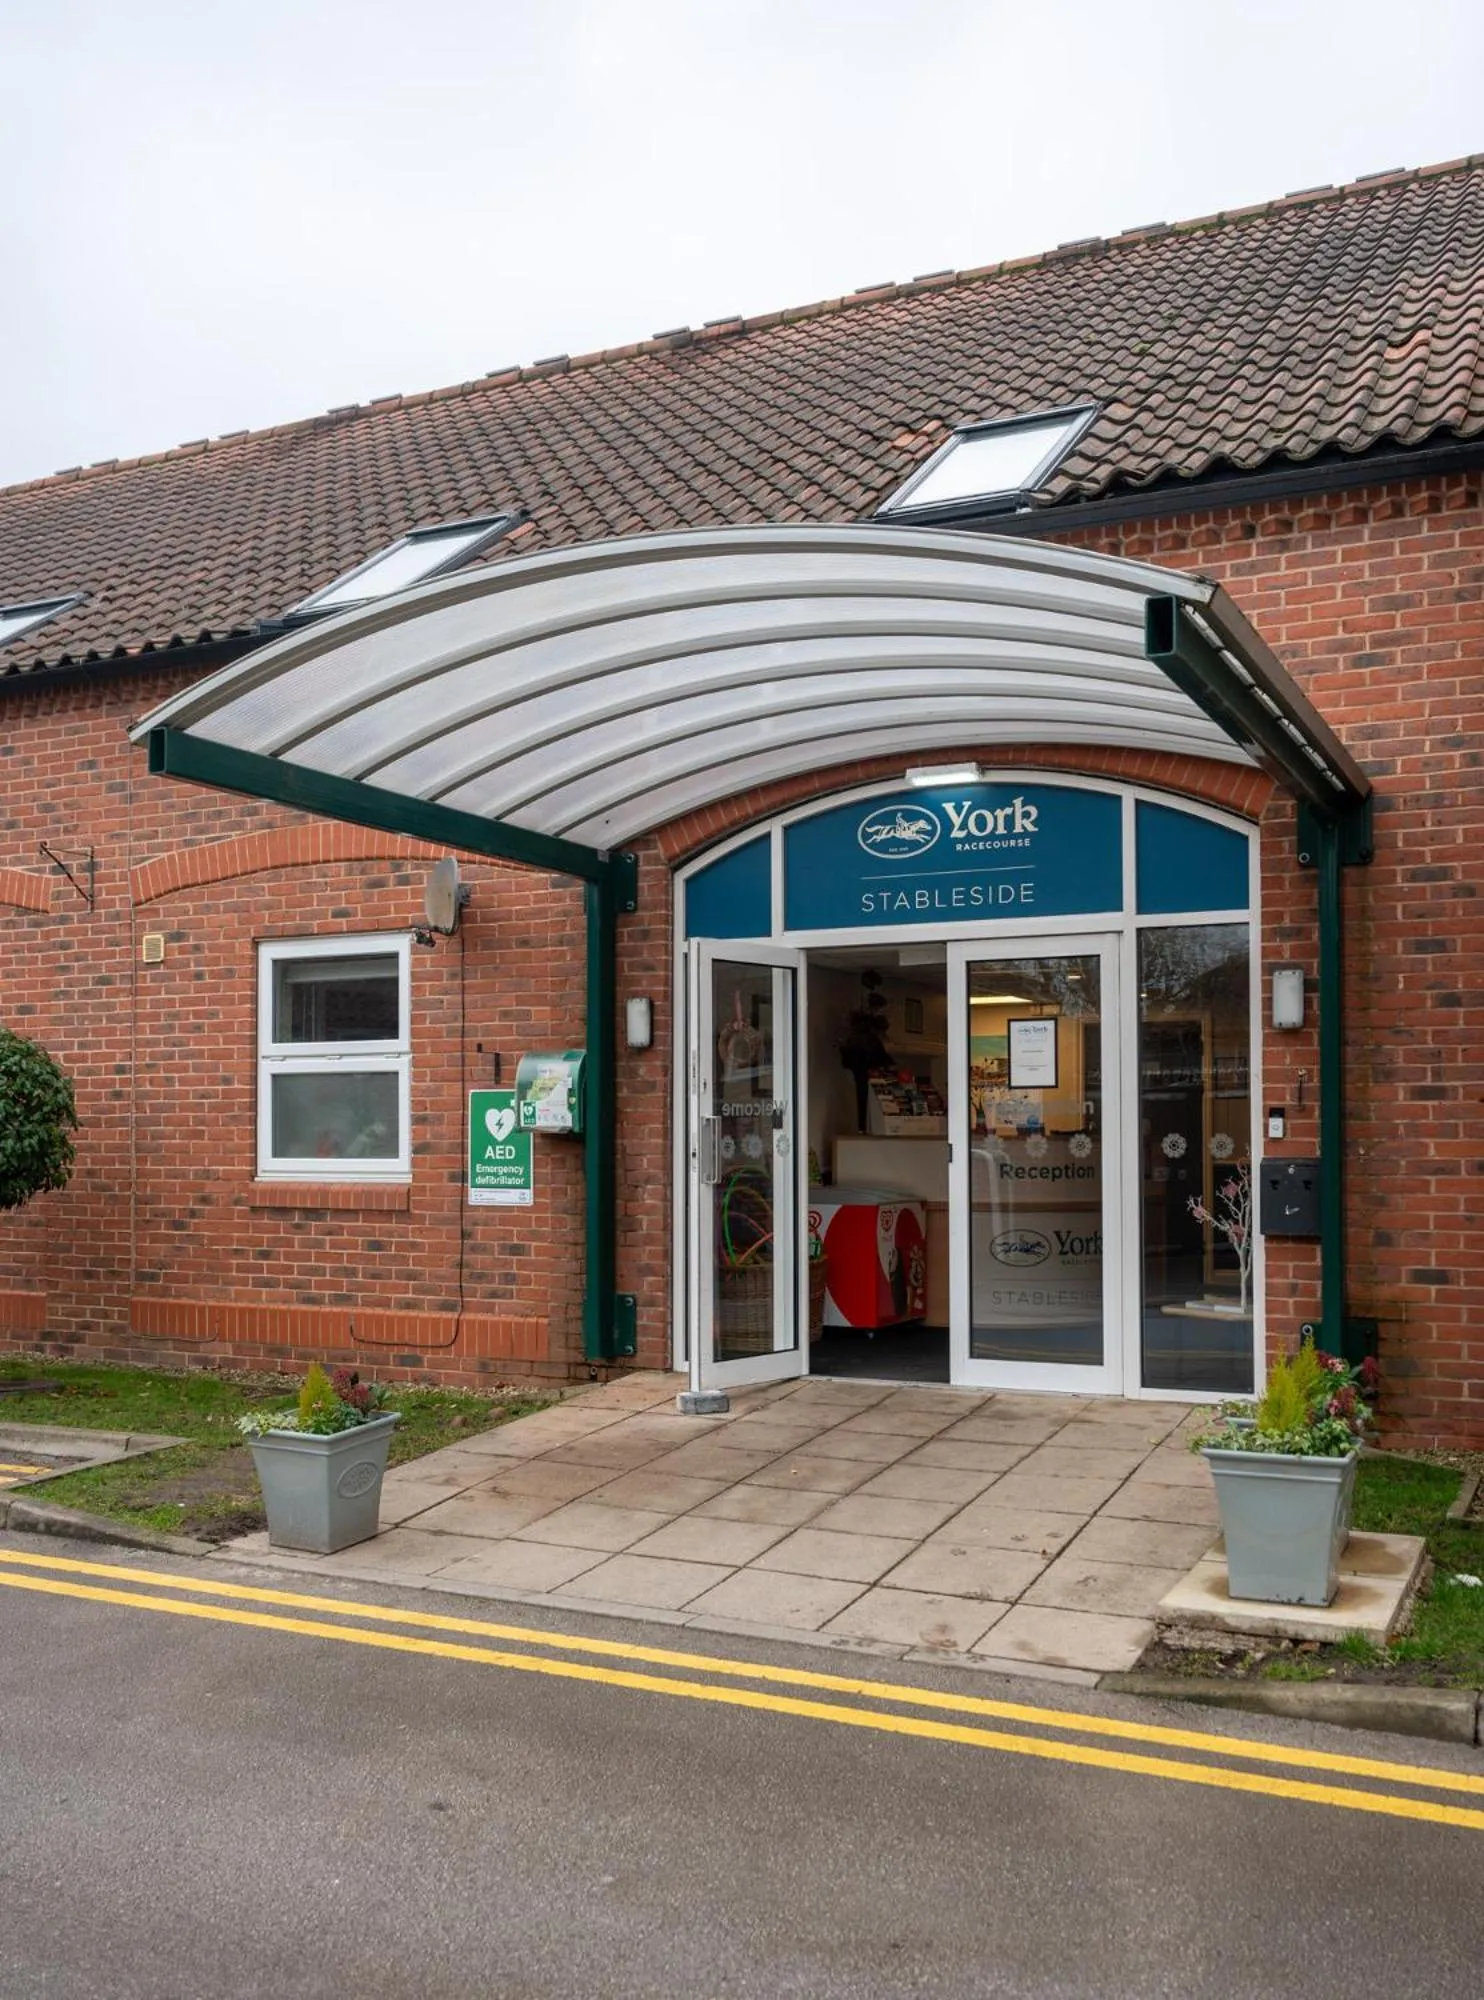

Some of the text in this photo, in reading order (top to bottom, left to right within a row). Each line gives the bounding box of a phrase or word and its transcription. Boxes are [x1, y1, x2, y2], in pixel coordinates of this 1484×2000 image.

[941, 796, 1039, 838] York
[956, 838, 1031, 851] RACECOURSE
[861, 883, 1035, 912] STABLESIDE
[484, 1145, 516, 1160] AED
[475, 1163, 525, 1176] Emergency
[1000, 1163, 1095, 1182] Reception
[475, 1175, 525, 1185] defibrillator
